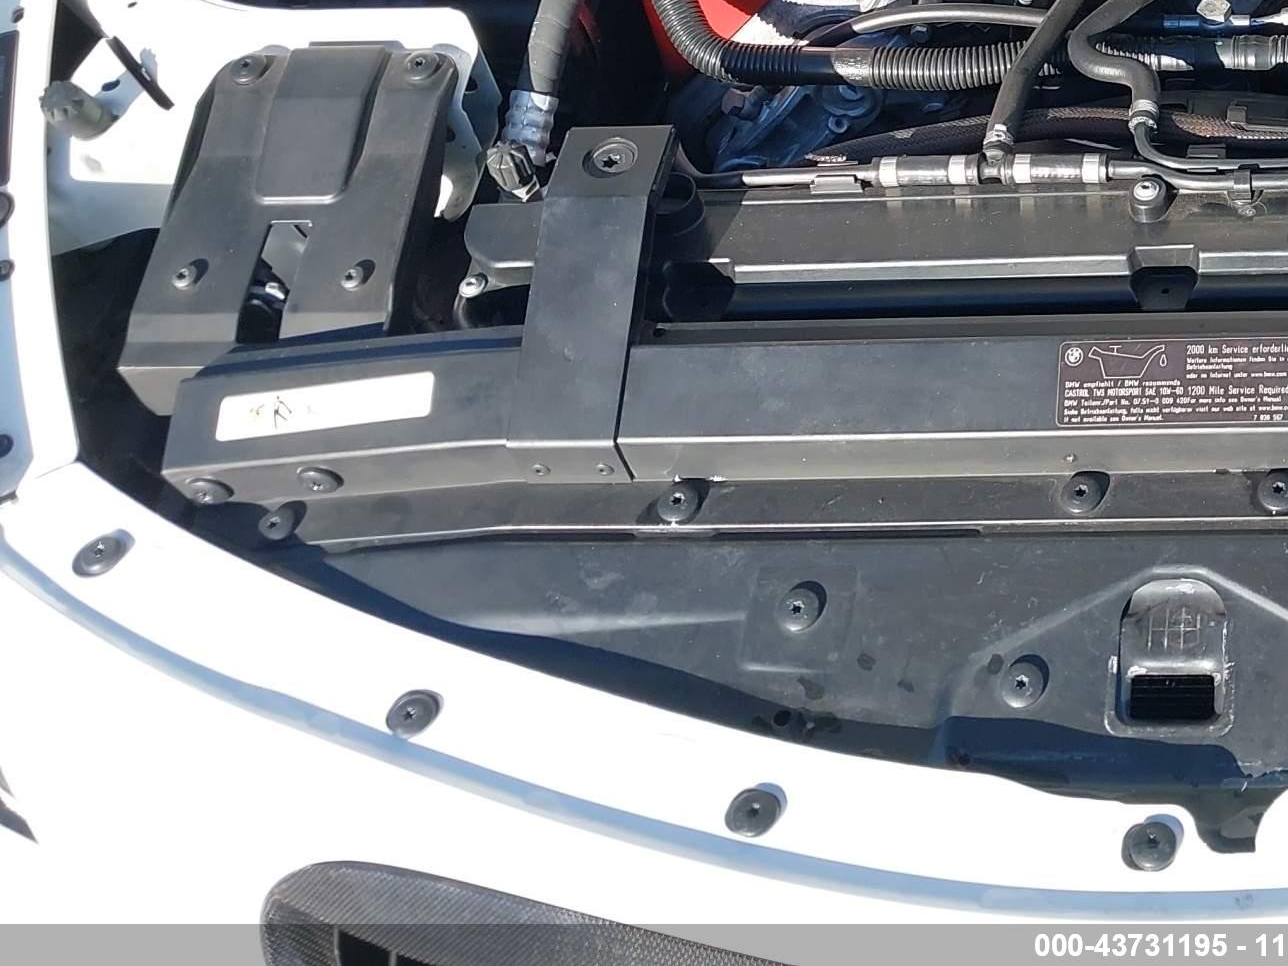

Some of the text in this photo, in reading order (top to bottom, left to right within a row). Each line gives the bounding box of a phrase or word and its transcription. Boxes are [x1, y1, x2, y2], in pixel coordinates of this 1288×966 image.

[1186, 344, 1205, 355] 2000
[1208, 345, 1219, 354] km
[1222, 344, 1249, 354] Service
[1107, 387, 1142, 396] MOTORSPORT
[1145, 387, 1156, 396] SAE
[1188, 386, 1206, 395] 1200
[1208, 385, 1225, 395] Mile
[1228, 384, 1256, 395] Service
